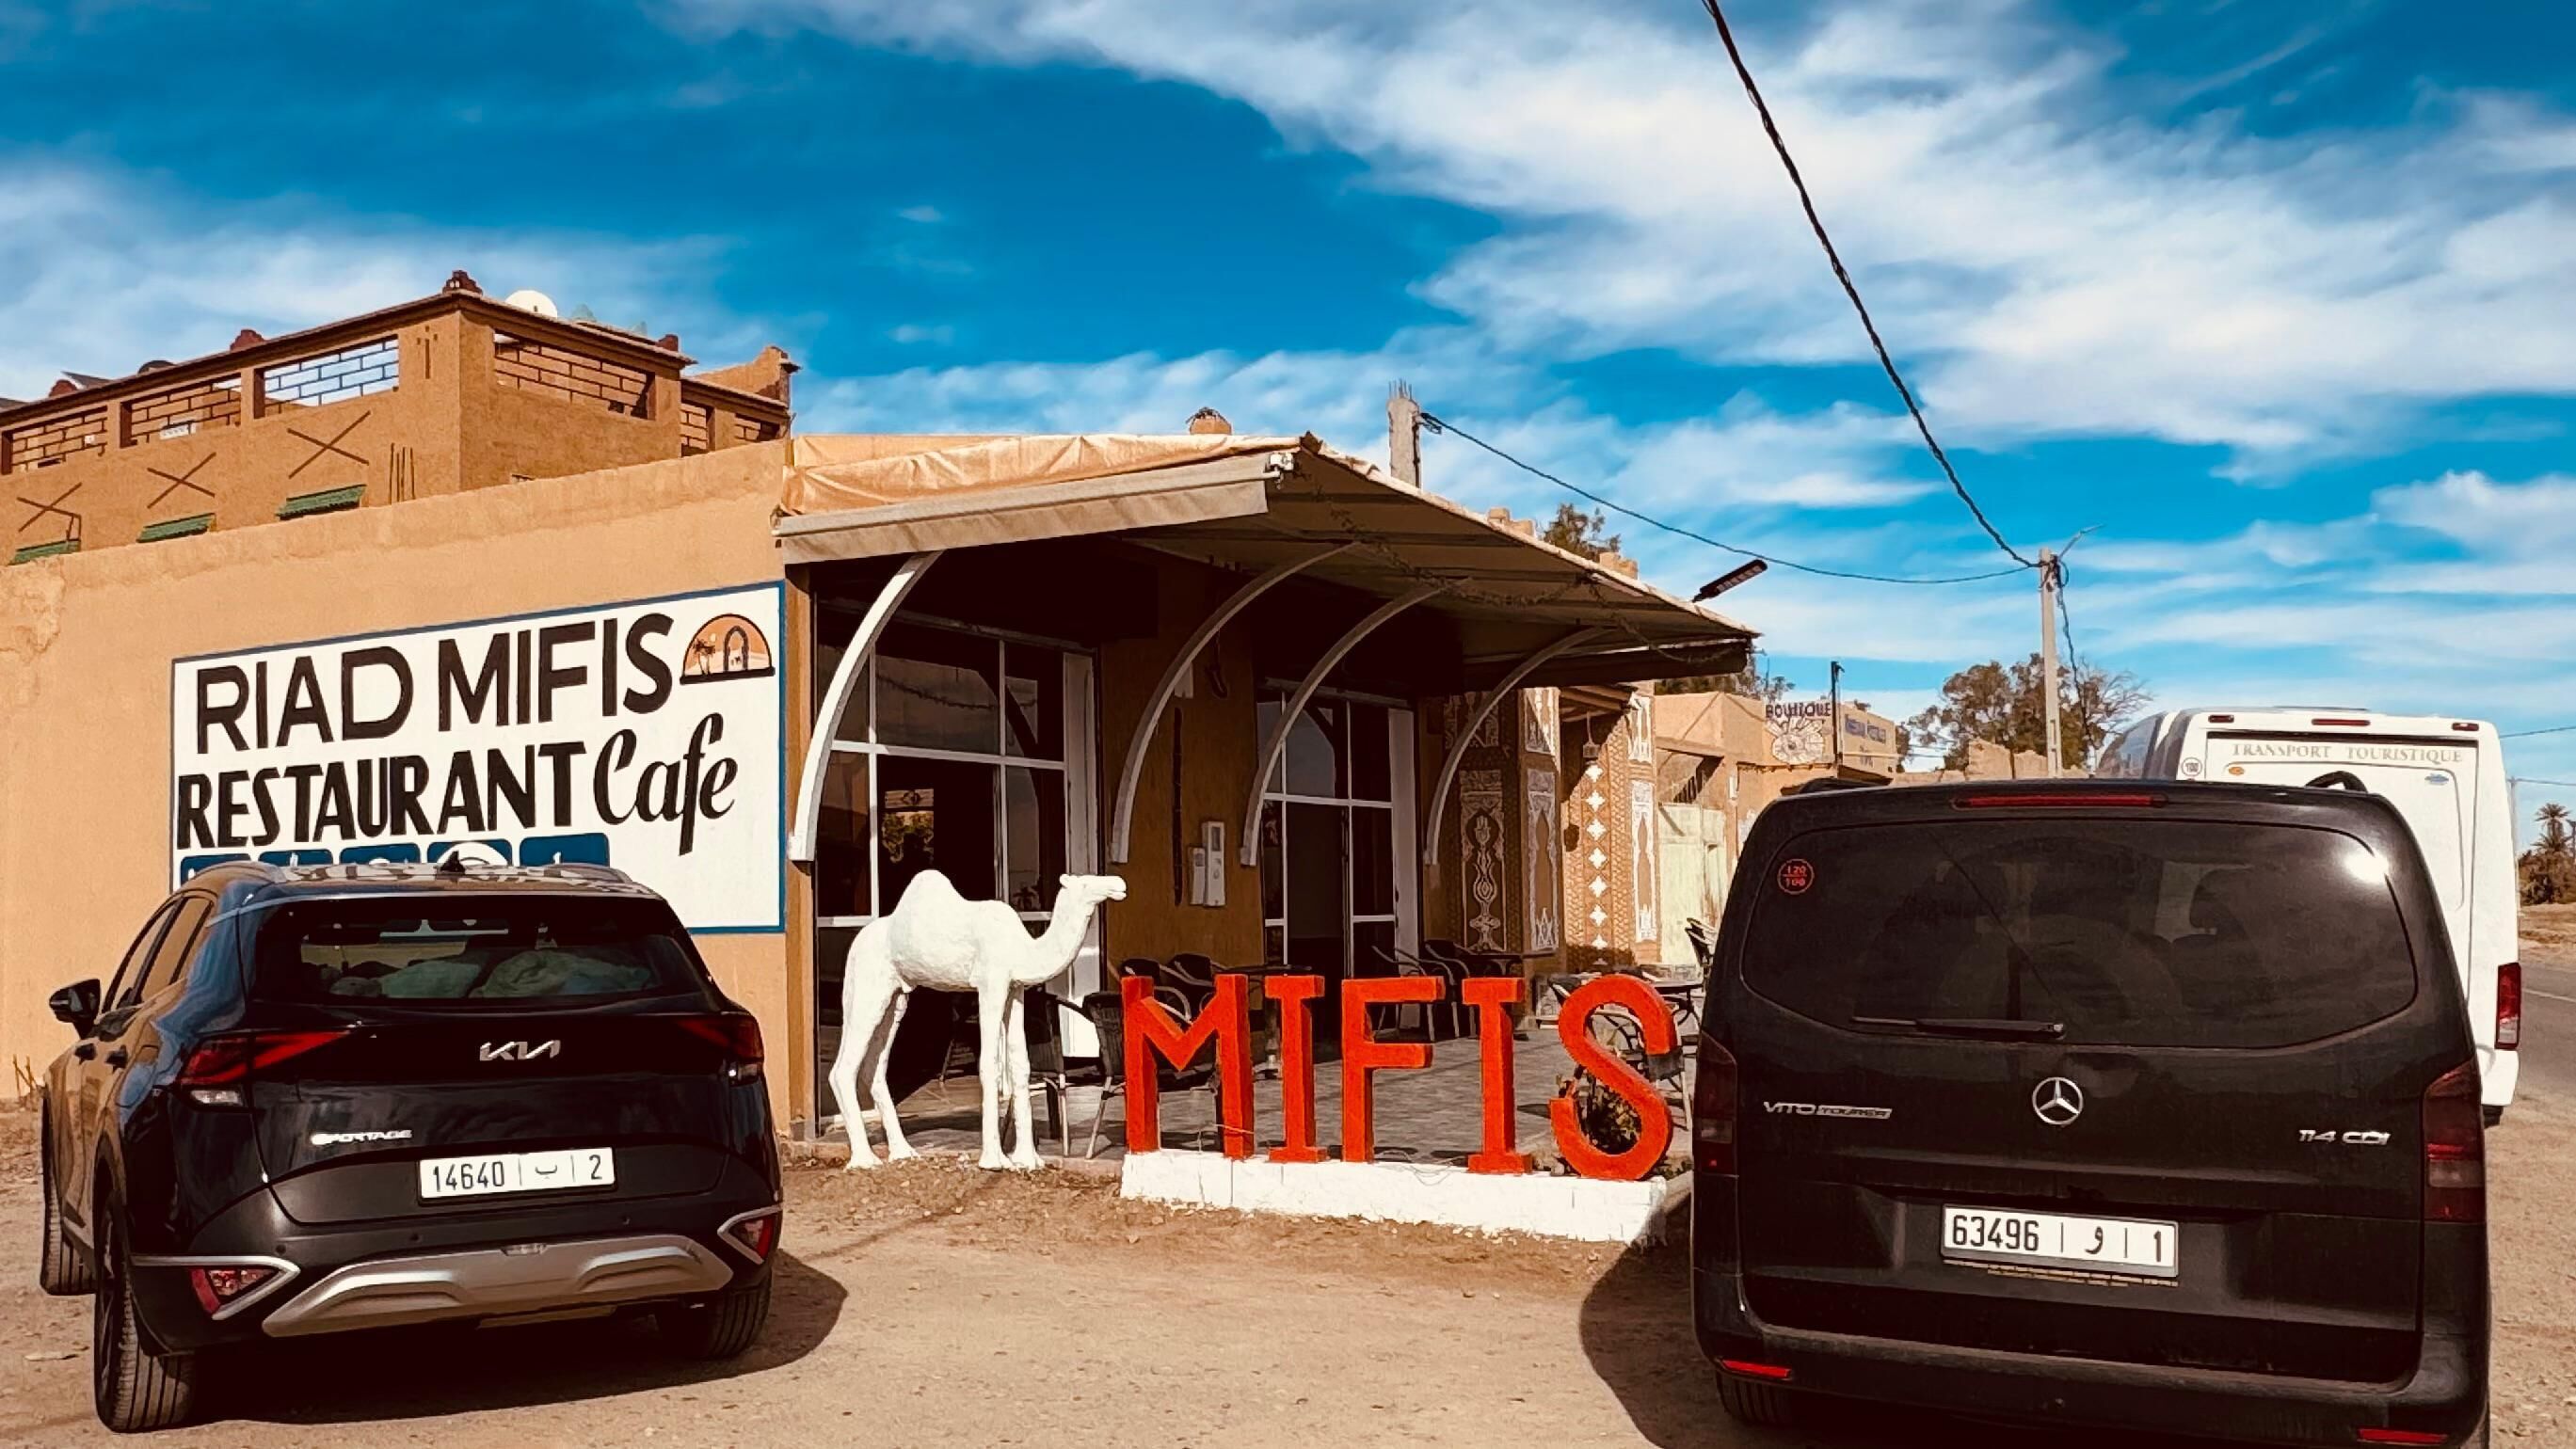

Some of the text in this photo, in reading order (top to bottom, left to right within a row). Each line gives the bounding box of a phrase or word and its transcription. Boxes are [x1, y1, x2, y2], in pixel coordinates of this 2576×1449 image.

[196, 613, 675, 754] RIAD MIFIS
[1766, 702, 1831, 718] BOUTIQUE
[2232, 743, 2463, 764] TRANSPORT TOURISTIQUE
[177, 712, 738, 856] RESTAURANT Cafe
[479, 1040, 561, 1061] KIA
[1121, 973, 1676, 1181] MIFIS
[1763, 1101, 1816, 1116] VITO
[2299, 1129, 2337, 1142] 114
[432, 1161, 505, 1192] 14640
[588, 1154, 603, 1180] 2
[1952, 1214, 2040, 1252] 63496
[2152, 1230, 2162, 1263] 1
